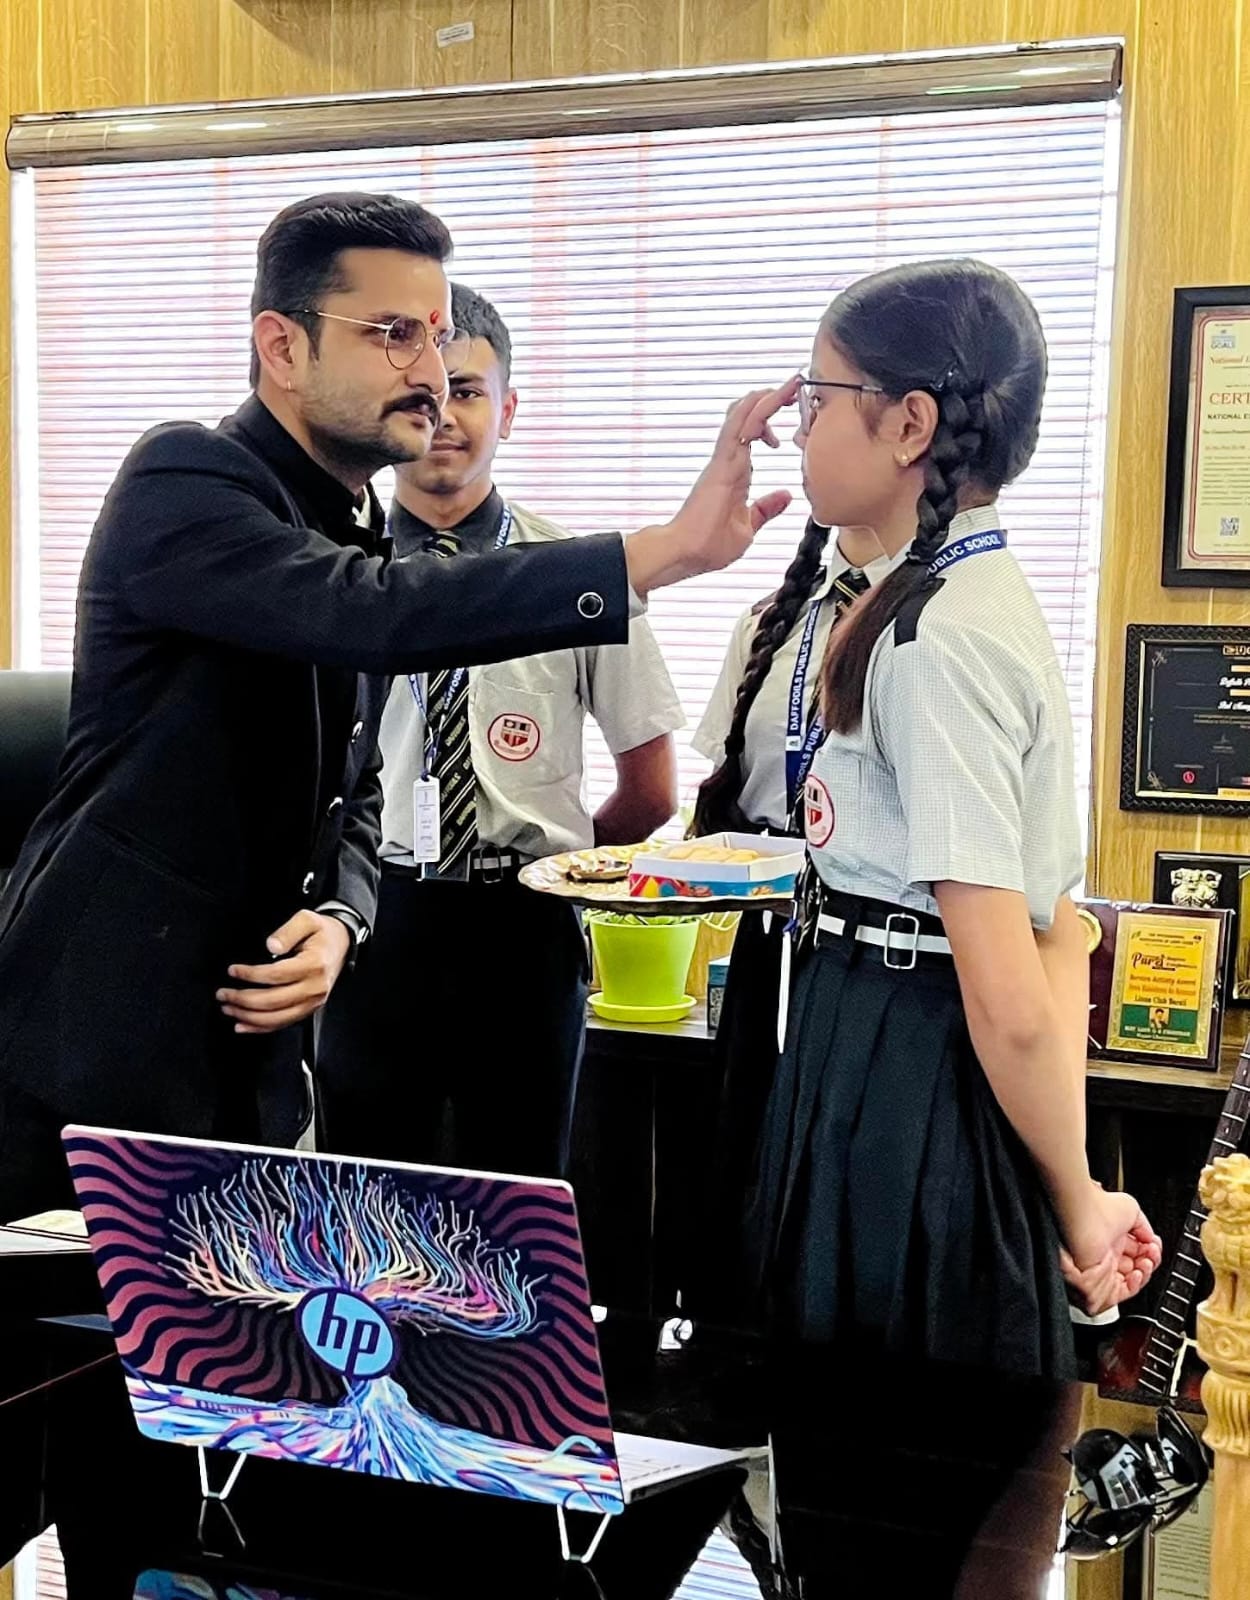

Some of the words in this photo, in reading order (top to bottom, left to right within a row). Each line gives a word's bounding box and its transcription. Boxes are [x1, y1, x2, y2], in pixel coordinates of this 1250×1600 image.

[796, 643, 809, 677] PUBLIC
[790, 676, 803, 731] DAFFODILS
[317, 1291, 380, 1376] hp
